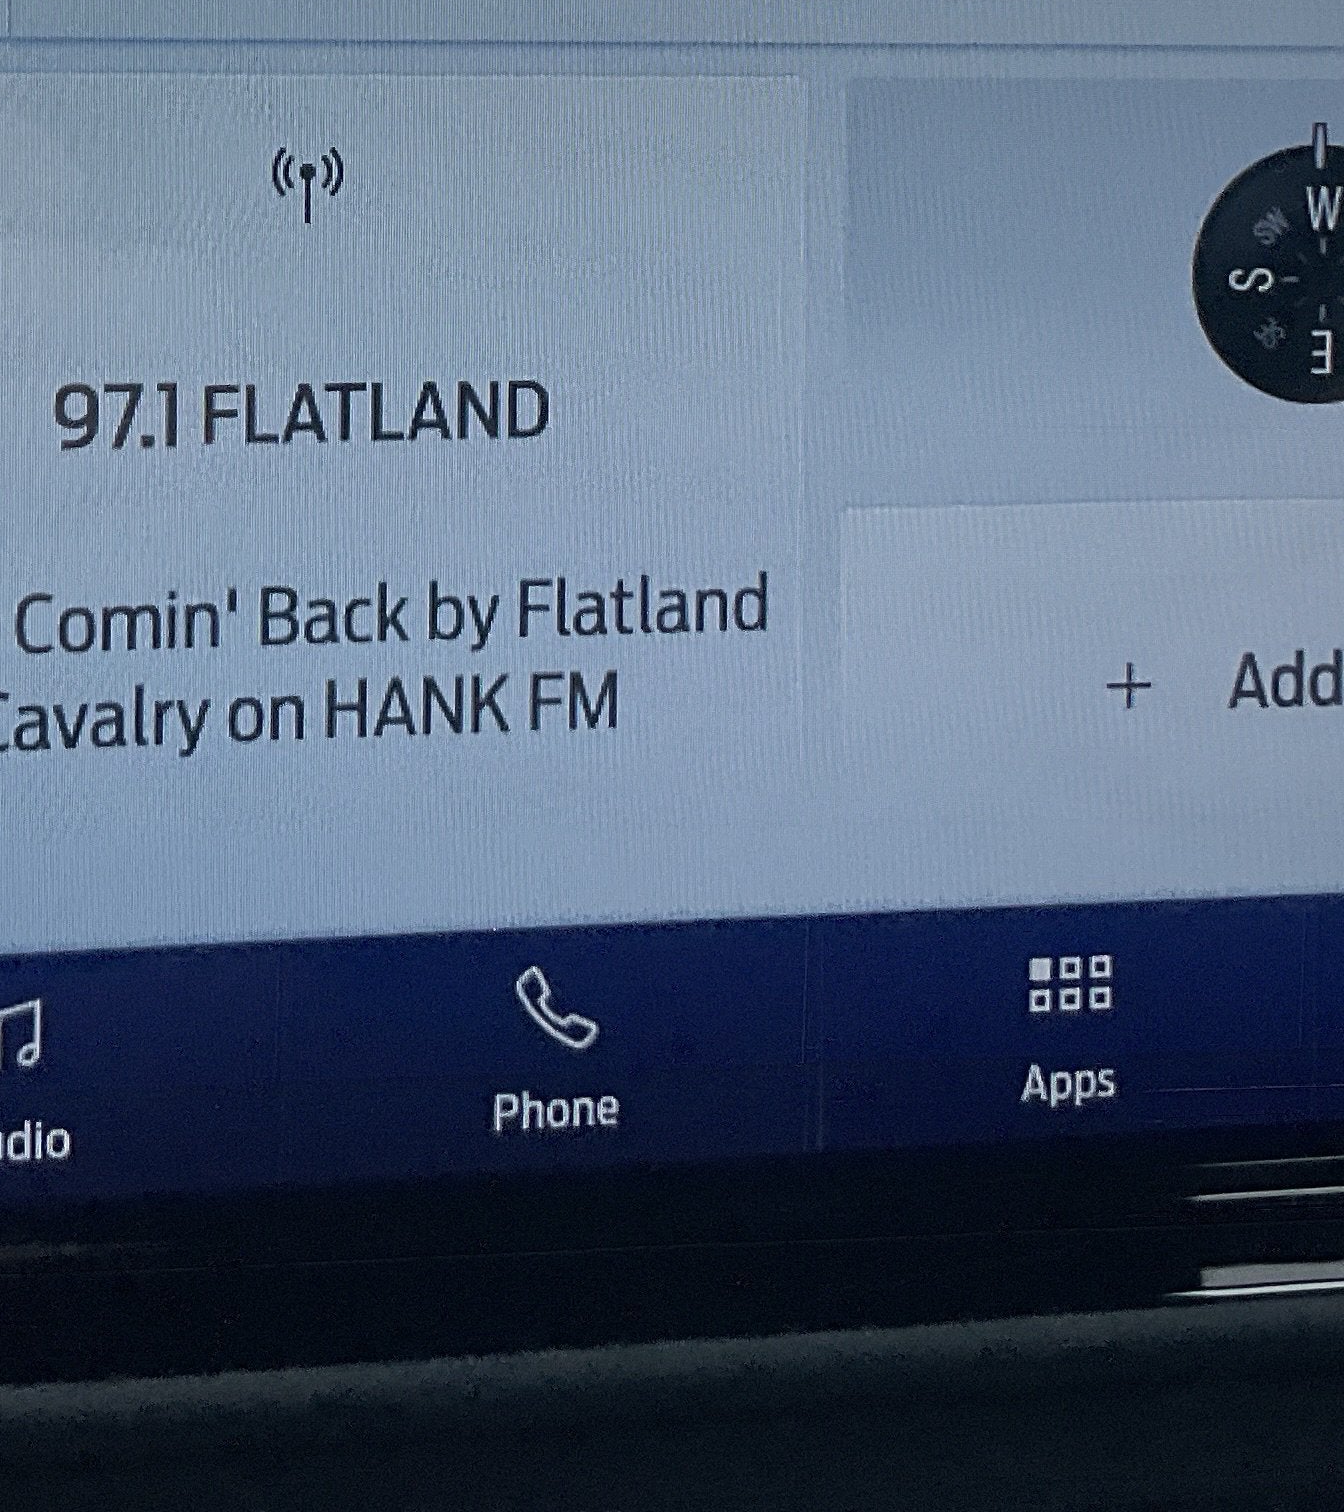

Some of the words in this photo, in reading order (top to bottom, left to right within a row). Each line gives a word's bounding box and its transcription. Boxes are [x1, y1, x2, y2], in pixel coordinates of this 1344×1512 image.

[1306, 186, 1344, 231] W
[1228, 267, 1275, 293] S
[1310, 329, 1333, 375] E
[54, 382, 178, 451] 97.1
[203, 381, 551, 445] FLATLAND
[15, 587, 238, 655] Comin'
[260, 581, 409, 646] Back
[428, 580, 501, 652] by
[518, 571, 769, 638] Flatland
[1227, 647, 1344, 709] Add
[227, 695, 305, 742] on
[325, 672, 511, 738] HANK
[529, 669, 619, 732] FM
[1020, 1063, 1117, 1107] Apps
[493, 1090, 620, 1133] Phone
